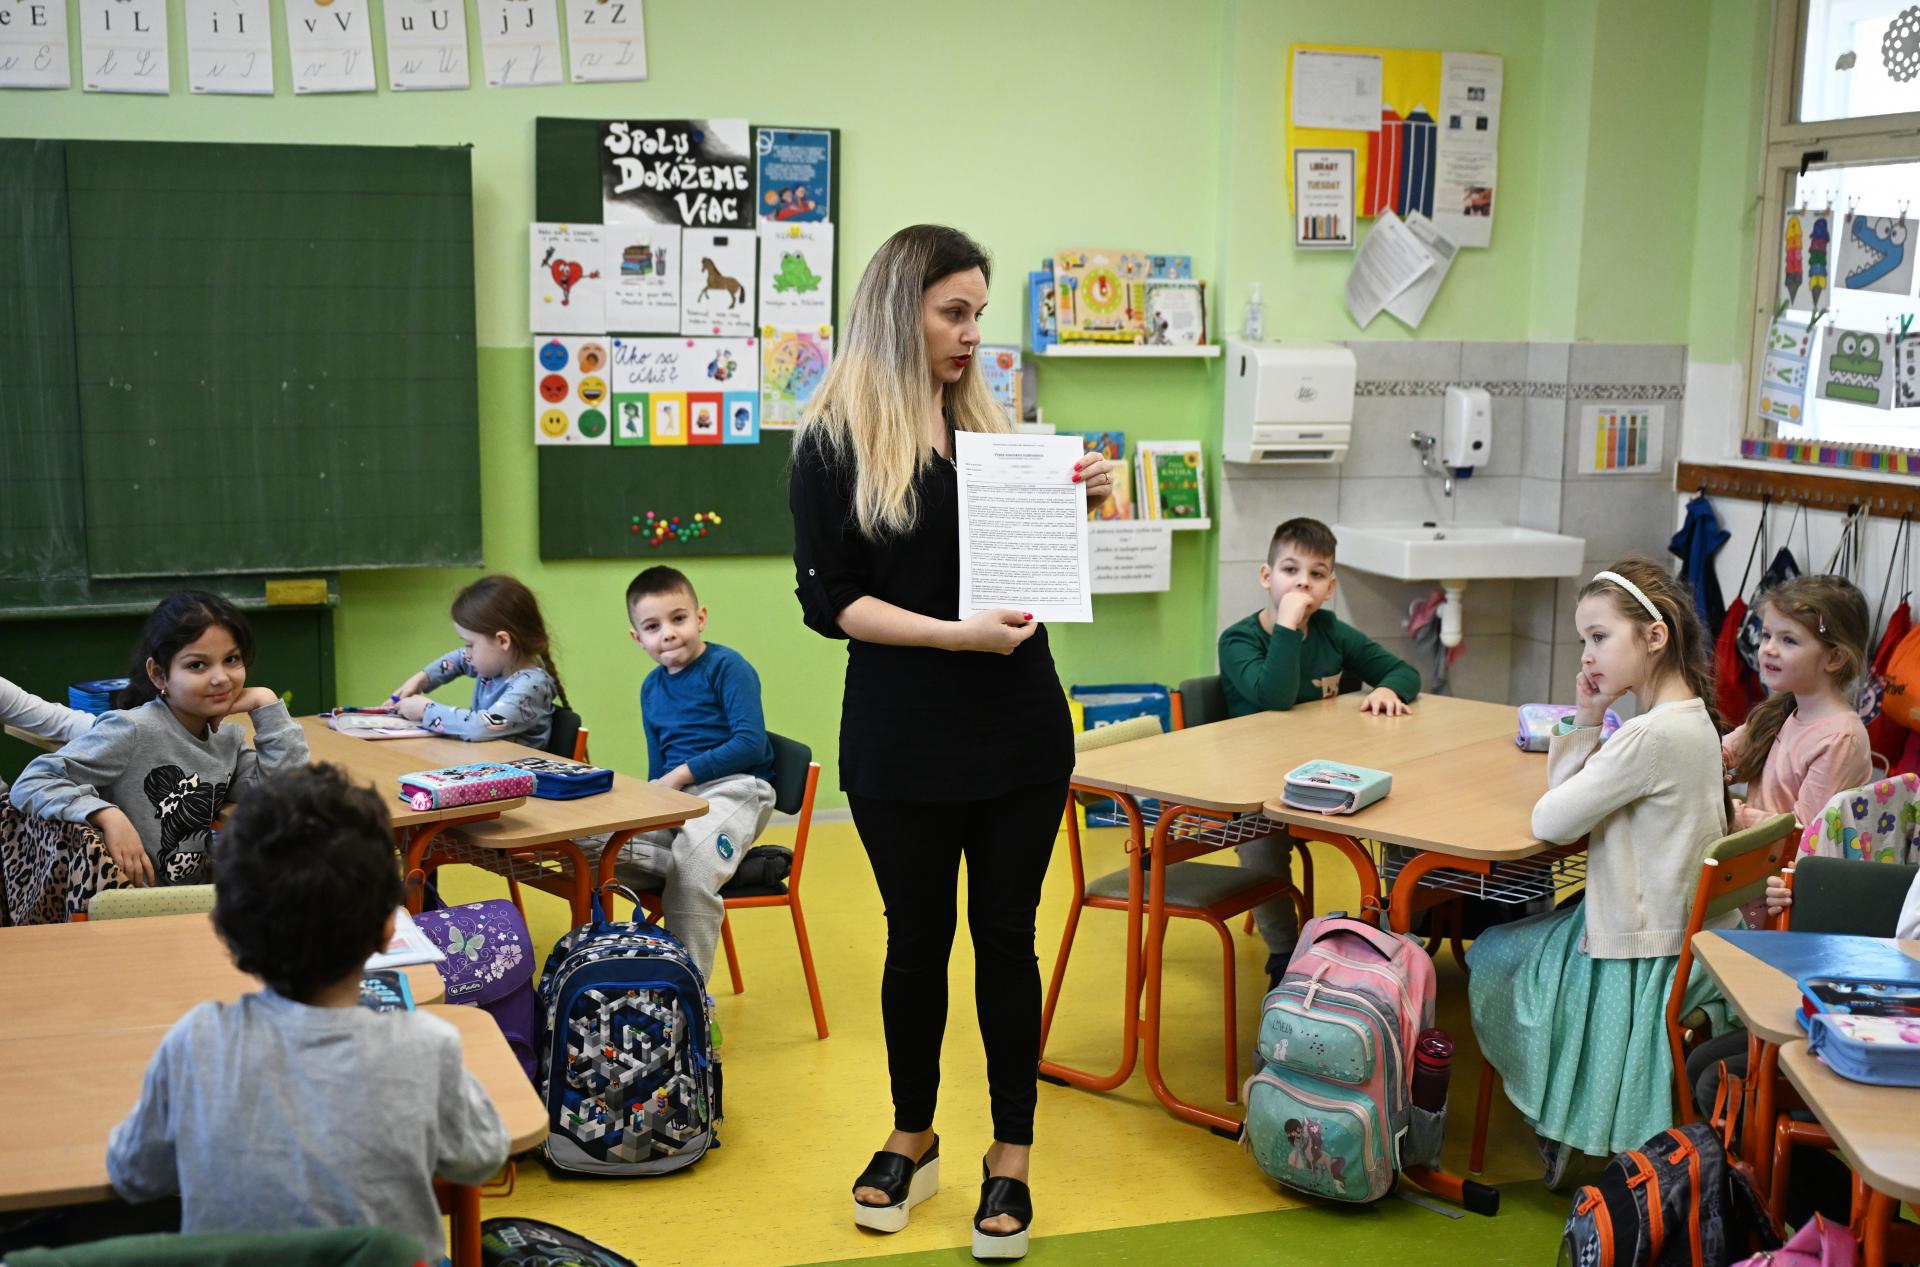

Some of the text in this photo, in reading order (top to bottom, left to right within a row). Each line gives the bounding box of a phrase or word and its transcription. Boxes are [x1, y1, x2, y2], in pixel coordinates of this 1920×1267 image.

[0, 5, 47, 26] e E
[134, 11, 150, 32] L
[237, 13, 245, 33] I
[304, 12, 352, 33] v V
[401, 10, 449, 31] u U
[500, 8, 535, 35] j J
[584, 3, 627, 25] z Z
[615, 344, 679, 365] Ako sa
